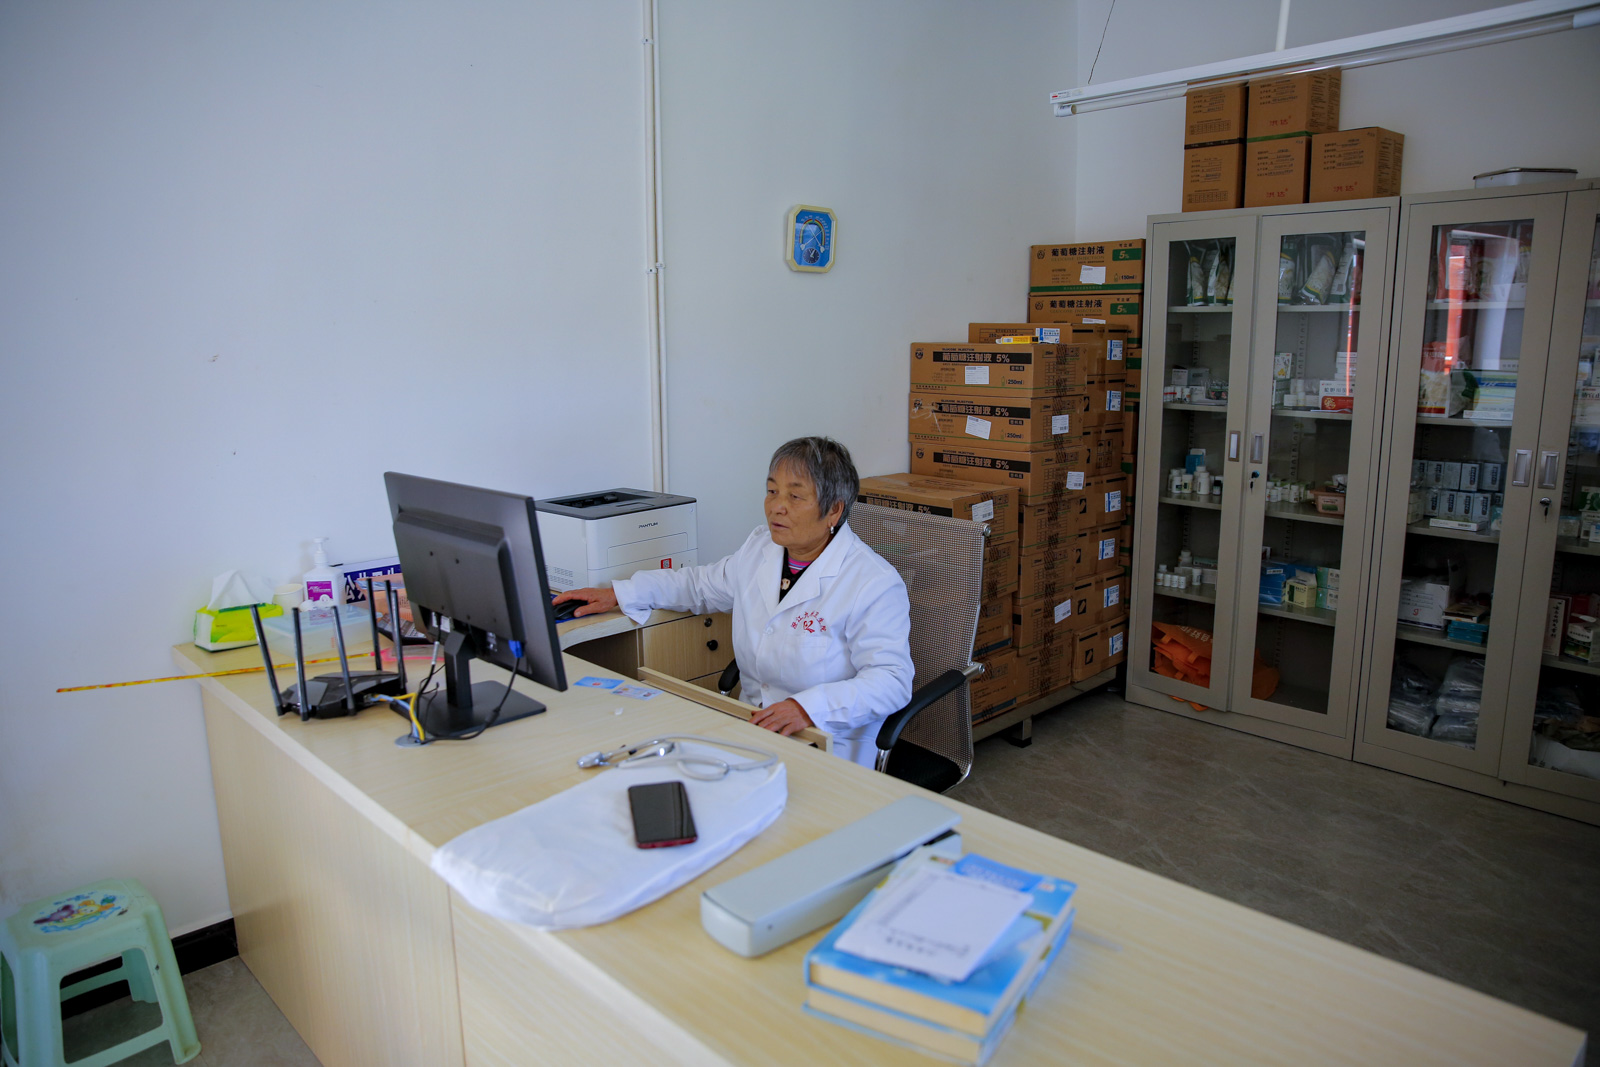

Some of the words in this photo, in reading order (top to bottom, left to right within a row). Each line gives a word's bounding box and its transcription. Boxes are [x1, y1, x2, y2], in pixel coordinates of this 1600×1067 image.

[1051, 246, 1105, 256] 葡萄糖注射液
[1119, 250, 1130, 259] 5%
[1050, 299, 1103, 309] 葡萄糖注射液
[1117, 304, 1128, 313] 5%
[942, 352, 992, 363] 葡萄糖注射液
[996, 354, 1010, 363] 5%
[942, 403, 991, 416] 葡萄糖注射液
[995, 407, 1010, 417] 5%
[942, 453, 992, 468] 葡萄糖注射液
[996, 460, 1010, 470] 5%
[918, 505, 932, 515] 5%
